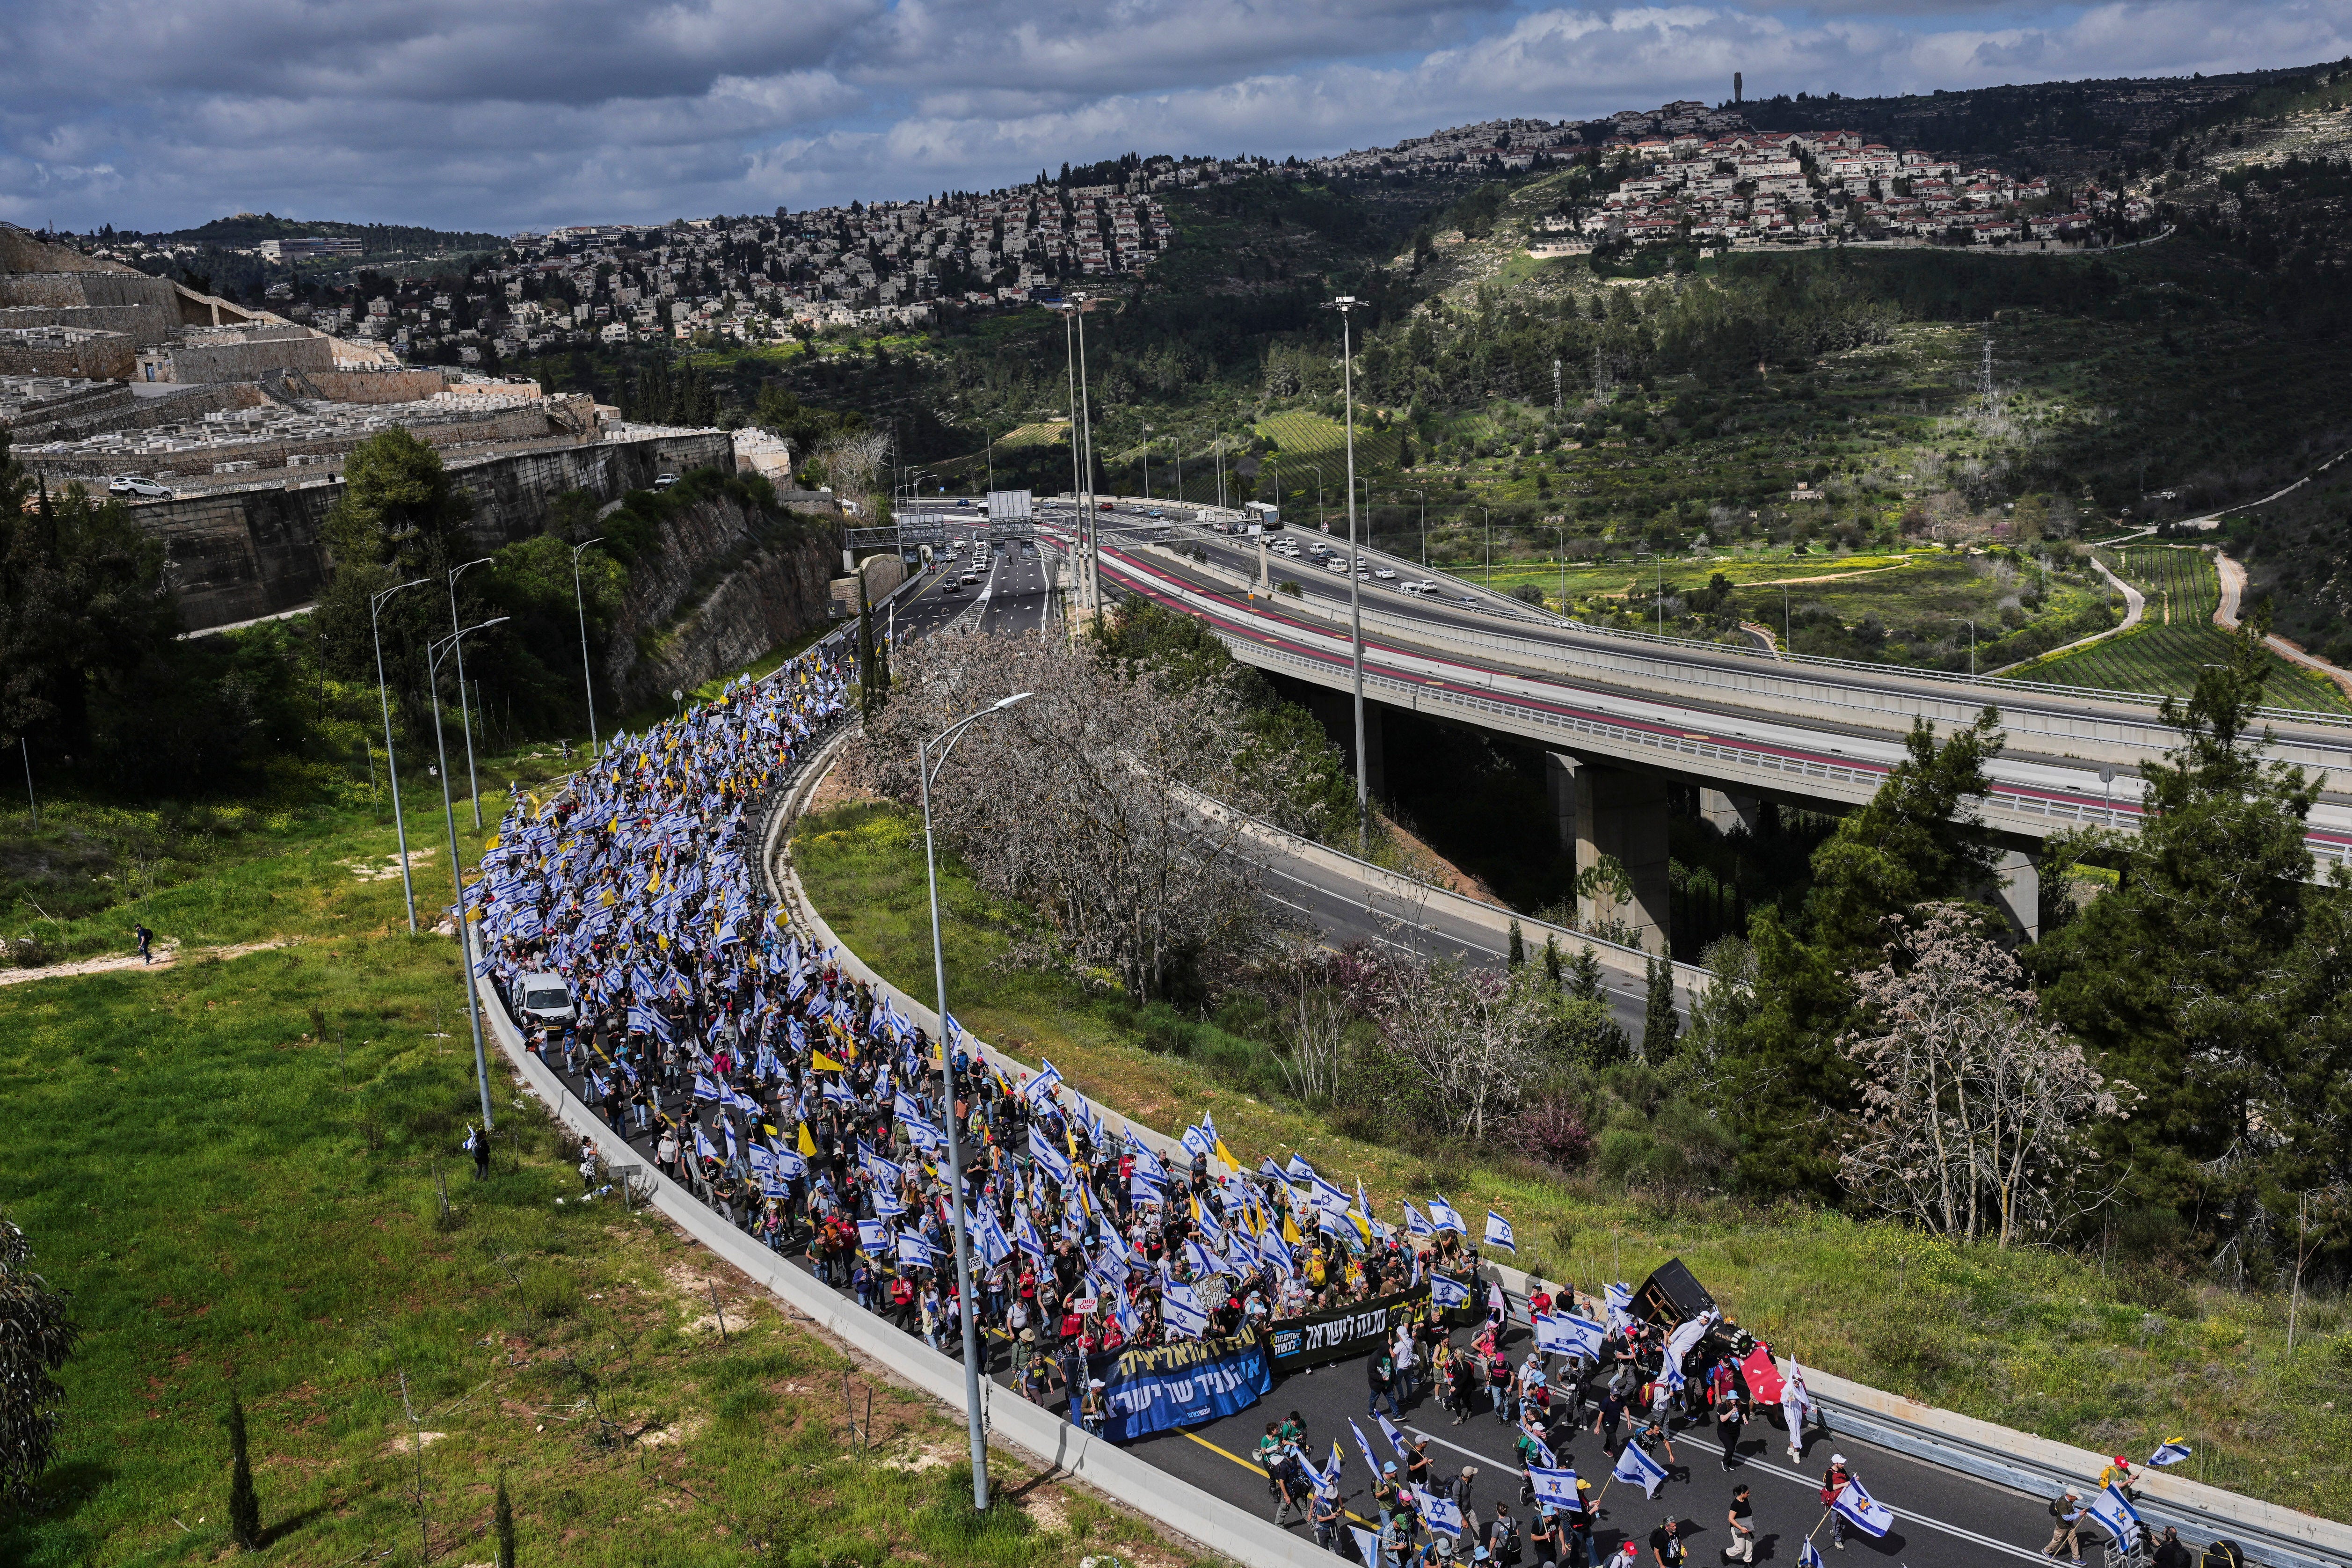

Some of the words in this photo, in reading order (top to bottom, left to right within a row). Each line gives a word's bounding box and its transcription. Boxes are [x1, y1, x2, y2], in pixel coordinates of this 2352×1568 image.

[1209, 1276, 1224, 1289] THE
[1198, 1287, 1227, 1309] EOPLE
[1306, 1315, 1354, 1350] לישראל
[1357, 1309, 1386, 1338] סכנה
[1104, 1384, 1162, 1418] ישרא
[1160, 1378, 1194, 1404] של
